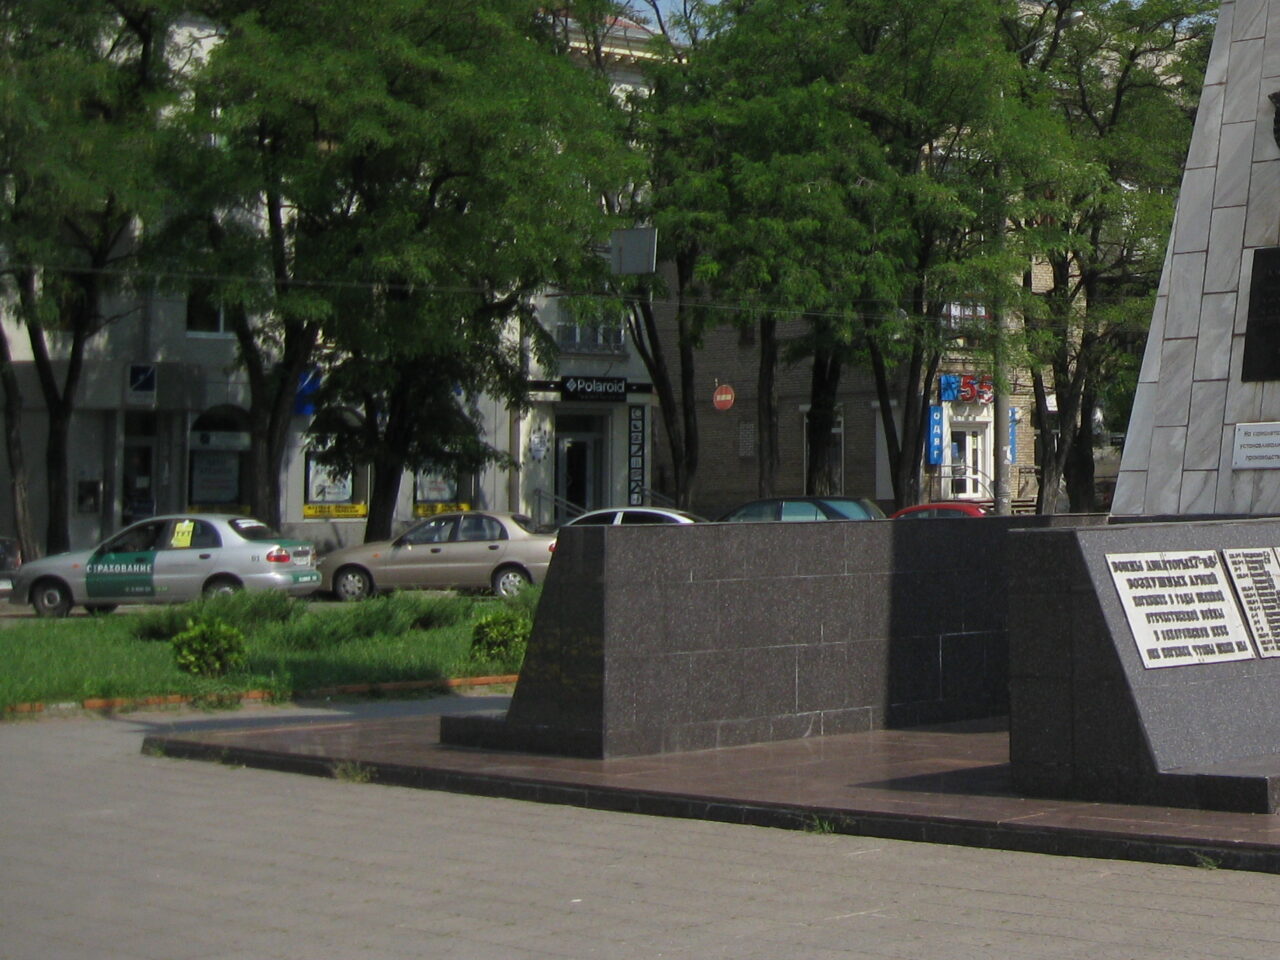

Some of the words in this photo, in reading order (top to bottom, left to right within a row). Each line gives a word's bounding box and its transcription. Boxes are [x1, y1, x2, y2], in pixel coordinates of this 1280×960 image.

[577, 379, 625, 393] Polaroid
[933, 412, 941, 458] ОДЯГ
[86, 563, 152, 574] СТРАХОВАНИЕ
[1126, 575, 1188, 590] ВОЗДУШНЫХ
